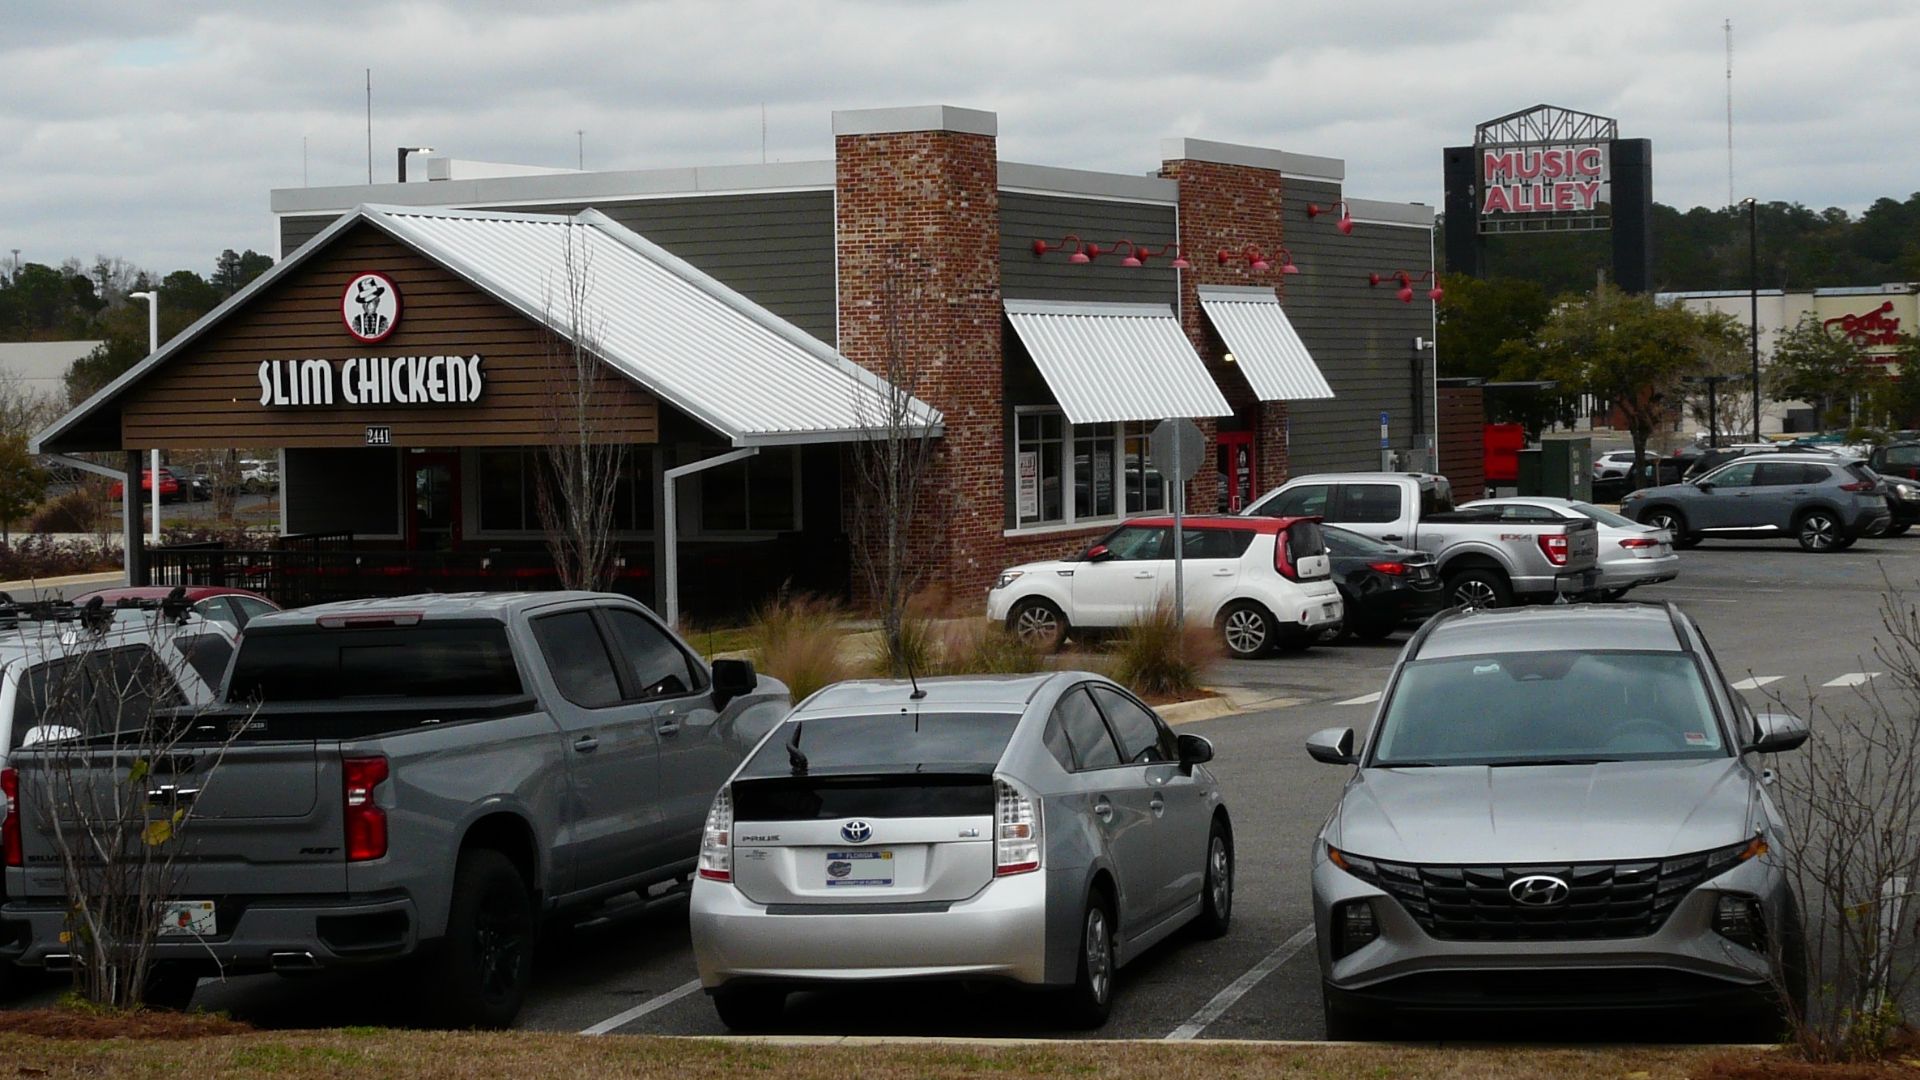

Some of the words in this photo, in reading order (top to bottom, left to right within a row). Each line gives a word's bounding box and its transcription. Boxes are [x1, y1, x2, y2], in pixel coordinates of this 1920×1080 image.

[1484, 148, 1602, 181] MUSIC
[1482, 180, 1603, 214] ALLEY
[258, 359, 333, 407] SLIM
[341, 354, 482, 404] CHICKENS
[367, 428, 390, 443] 2441
